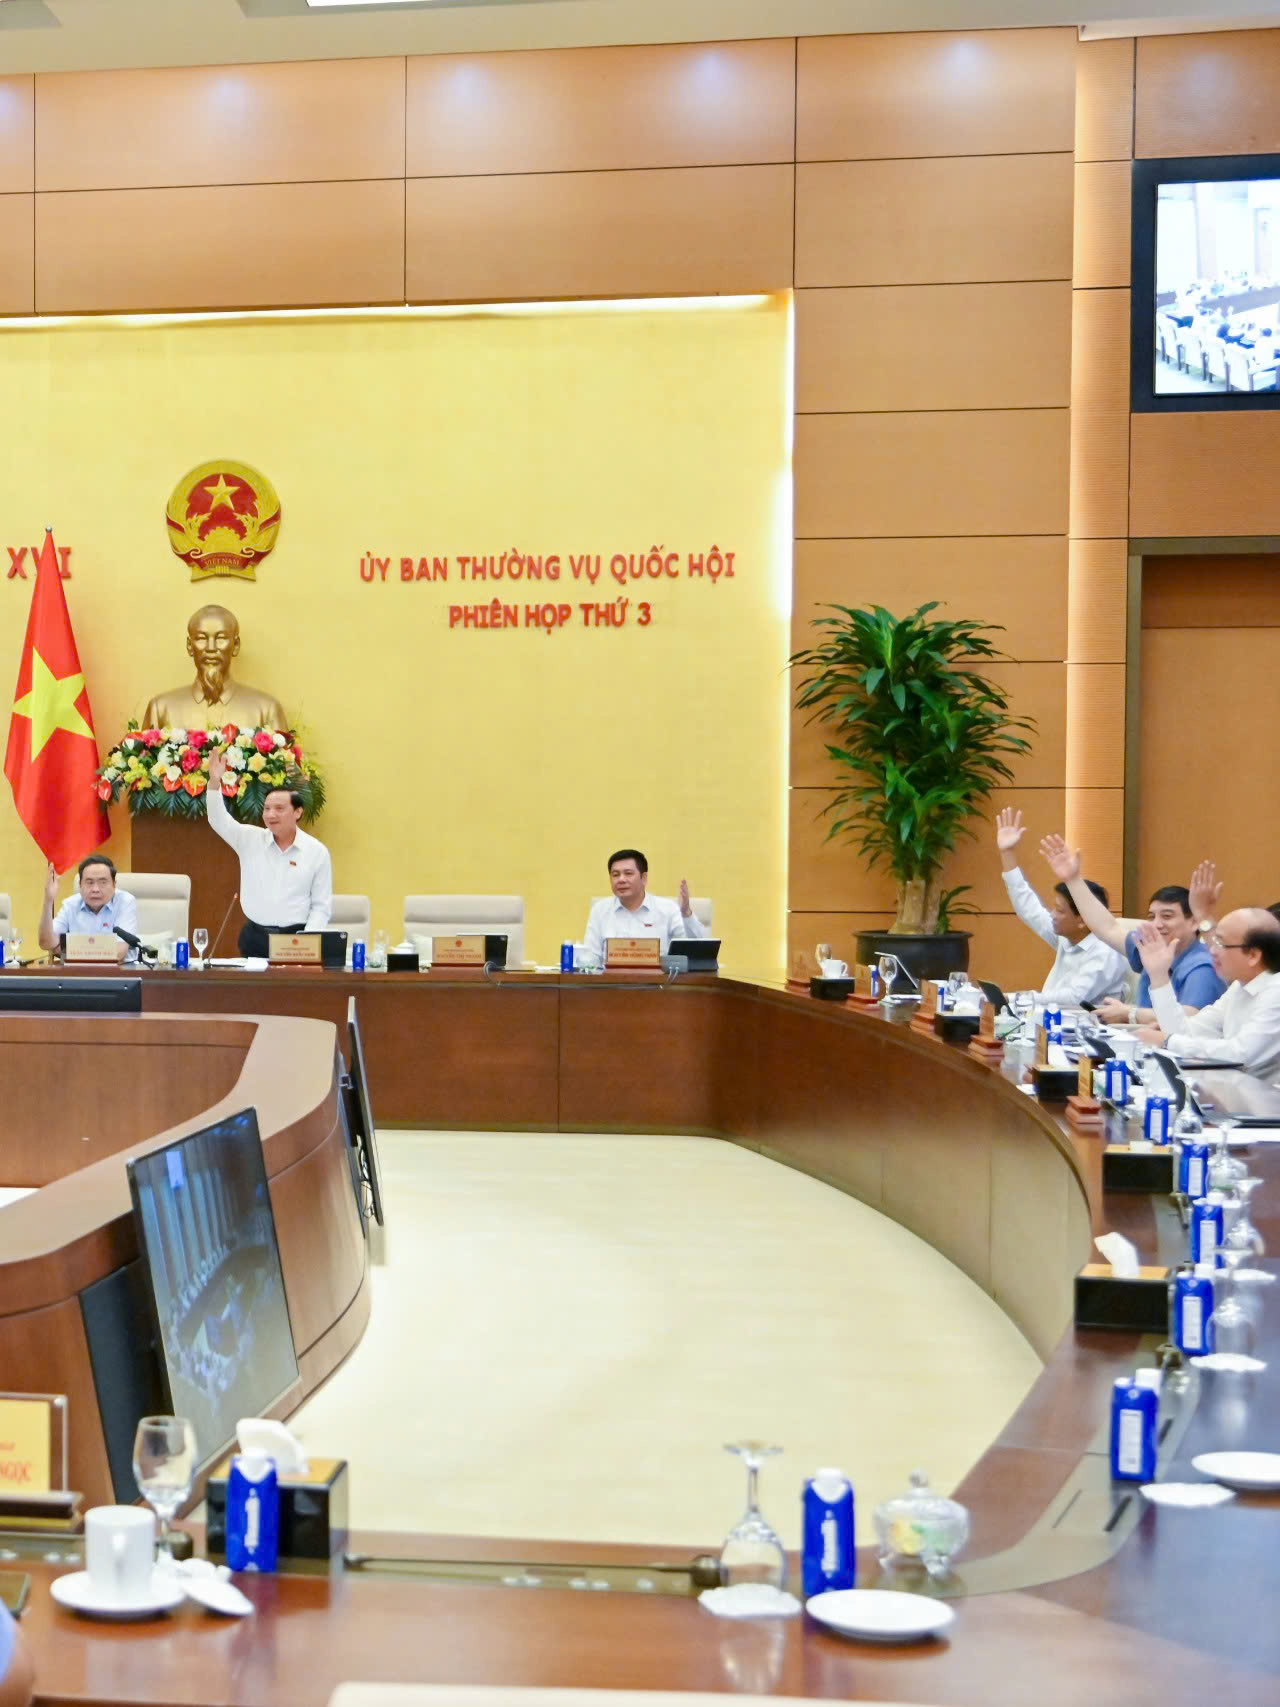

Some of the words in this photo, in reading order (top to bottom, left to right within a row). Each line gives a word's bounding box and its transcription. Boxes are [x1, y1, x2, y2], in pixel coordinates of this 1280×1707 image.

[360, 551, 391, 582] ỦY
[400, 556, 448, 582] BAN
[456, 548, 561, 581] THƯỜNG
[569, 554, 601, 585] VỤ
[610, 545, 680, 585] QUỐC
[688, 545, 735, 583] HỘI
[448, 597, 518, 629] PHIÊN
[525, 602, 572, 635] HỌP
[579, 597, 629, 628] THỨ
[638, 602, 652, 627] 3
